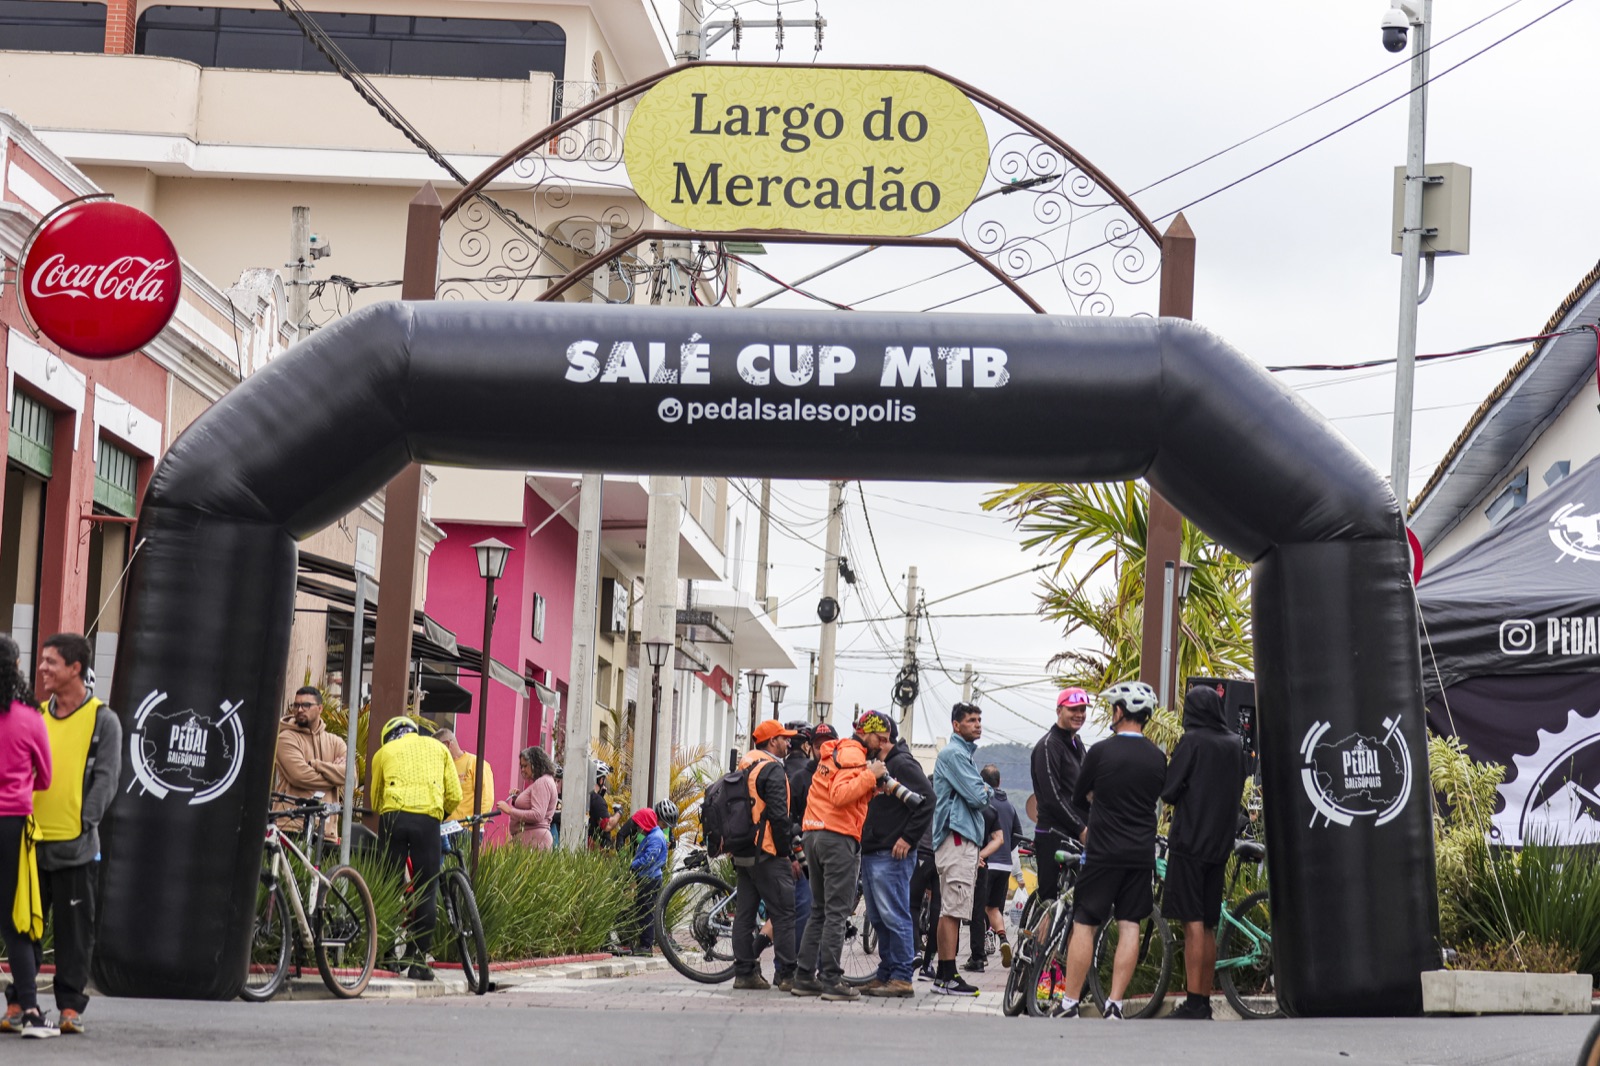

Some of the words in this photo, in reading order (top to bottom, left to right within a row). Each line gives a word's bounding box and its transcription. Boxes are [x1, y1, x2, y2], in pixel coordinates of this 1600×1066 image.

[690, 92, 844, 153] Largo
[863, 96, 928, 142] do
[671, 162, 941, 213] Mercadão
[30, 253, 174, 302] Coca-Cola
[564, 332, 711, 385] SALÉ
[736, 343, 857, 387] CUP
[879, 346, 1010, 389] MTB
[687, 397, 917, 427] pedalsalesopolis
[169, 725, 208, 754] PEDAL
[1342, 750, 1381, 776] PEDAL
